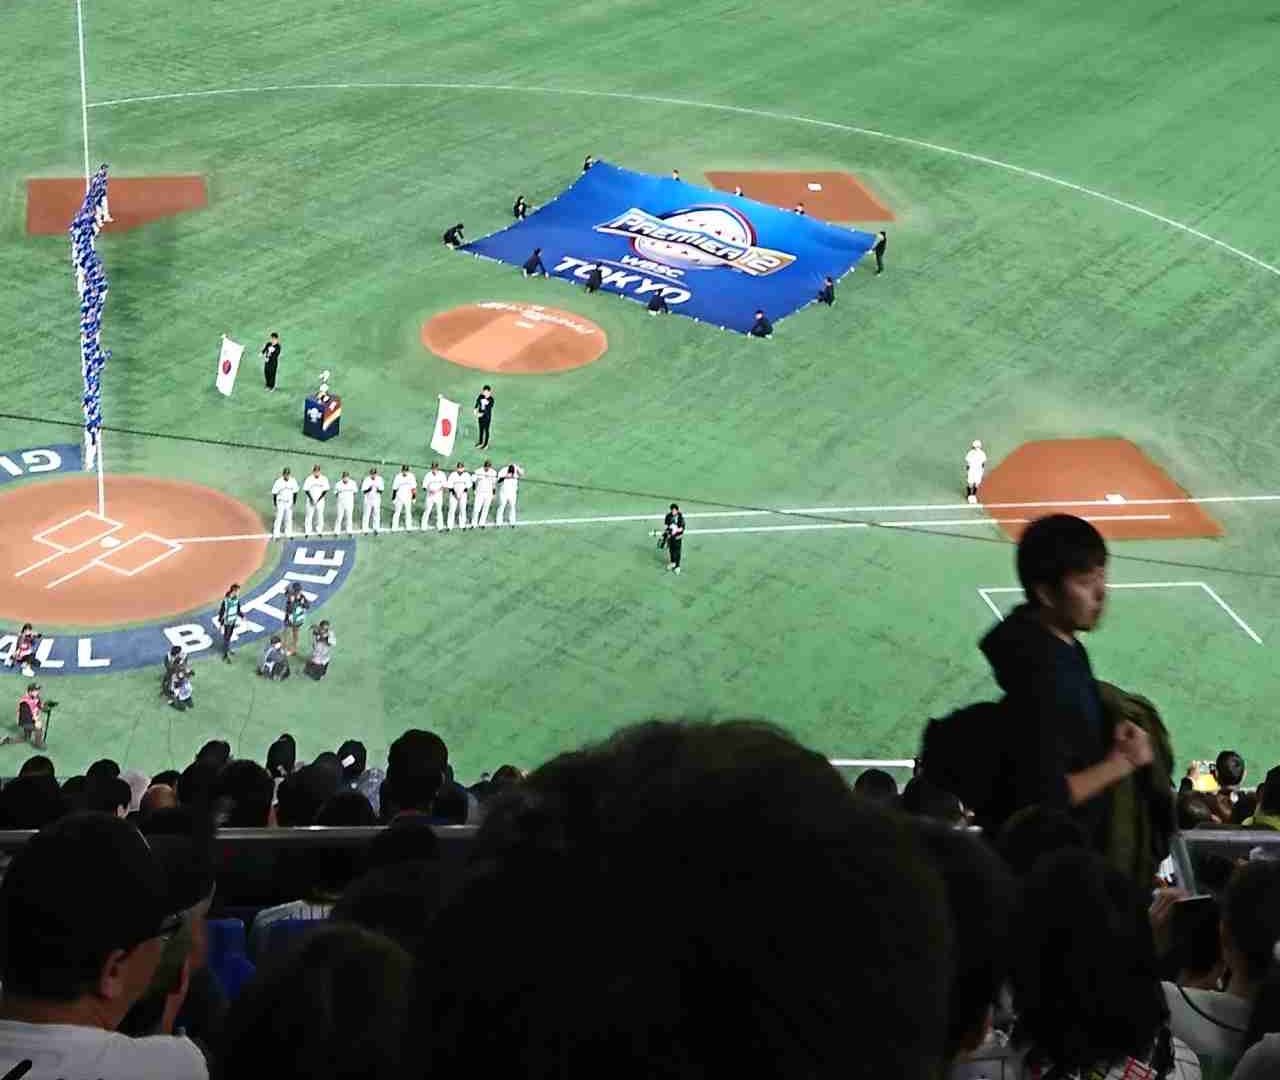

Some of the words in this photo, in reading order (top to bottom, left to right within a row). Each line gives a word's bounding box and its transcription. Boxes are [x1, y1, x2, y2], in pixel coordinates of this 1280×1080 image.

[610, 211, 741, 261] PREMIER
[740, 250, 784, 273] 12
[620, 254, 686, 279] WBSC
[553, 256, 693, 305] TOKYO
[163, 546, 346, 656] BATTLE
